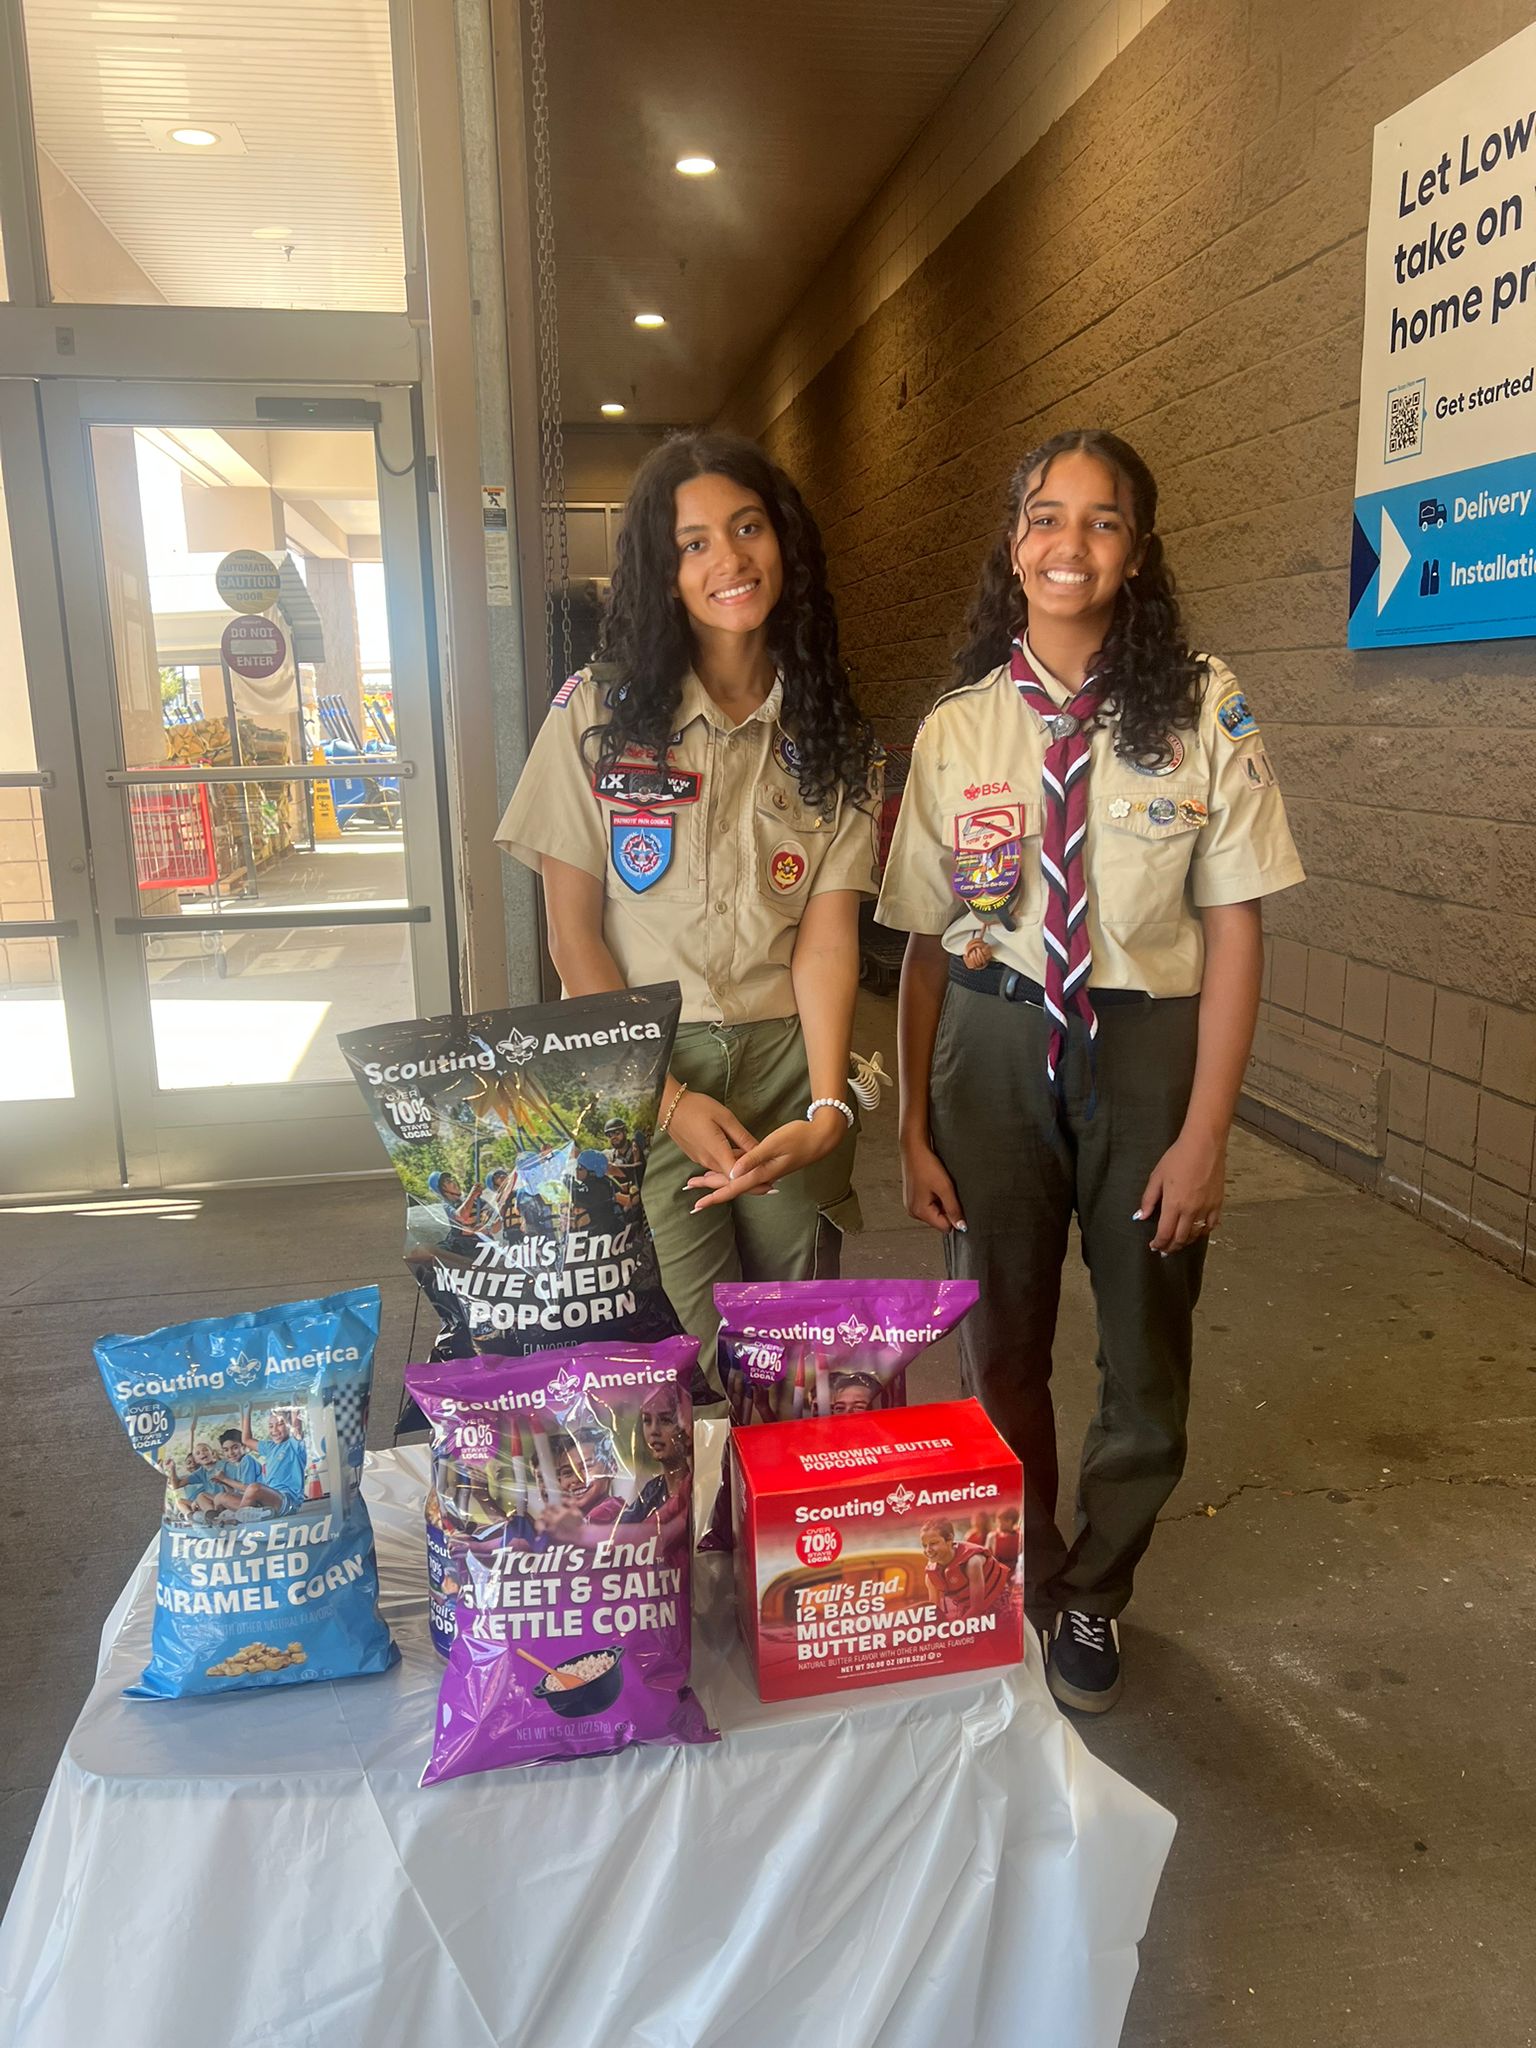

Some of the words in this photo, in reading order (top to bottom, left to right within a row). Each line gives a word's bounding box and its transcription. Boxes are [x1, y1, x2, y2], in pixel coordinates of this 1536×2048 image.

[1399, 152, 1451, 218] Let
[1460, 110, 1536, 185] Low
[1394, 221, 1467, 284] take
[1476, 194, 1522, 246] on
[1390, 285, 1482, 354] home
[1491, 260, 1536, 325] pr
[1435, 393, 1465, 419] Get
[1468, 367, 1534, 409] started
[1453, 489, 1532, 523] Delivery
[223, 563, 275, 572] AUTOMATIC
[219, 575, 277, 588] CAUTION
[236, 591, 263, 601] DOOR
[231, 628, 246, 638] DO
[250, 627, 275, 638] NOT
[236, 656, 274, 667] ENTER
[982, 781, 1012, 797] BSA
[363, 1049, 497, 1086] Scouting
[542, 1020, 662, 1055] America
[385, 1090, 418, 1103] OVER
[385, 1097, 431, 1126] 70%
[400, 1123, 429, 1132] STAYS
[402, 1130, 432, 1140] LOCAL
[471, 1235, 556, 1270] Trail's
[565, 1223, 631, 1265] End
[468, 1289, 638, 1331] POPCORN
[743, 1322, 835, 1346] Scouting
[754, 1341, 781, 1351] OVER
[747, 1346, 782, 1373] 70%
[750, 1367, 775, 1376] STAYS
[116, 1368, 225, 1401] Scouting
[264, 1346, 359, 1377] America
[750, 1372, 775, 1381] LOCAL
[440, 1388, 547, 1417] Scouting
[582, 1367, 678, 1392] America
[129, 1404, 160, 1414] OVER
[125, 1410, 168, 1437] 70%
[132, 1440, 162, 1450] LOCAL
[799, 1447, 893, 1464] MICROWAVE
[894, 1438, 954, 1453] BUTTER
[804, 1456, 879, 1472] POPCORN
[795, 1498, 886, 1524] Scouting
[916, 1483, 998, 1508] America
[168, 1529, 265, 1561] Trail's
[266, 1514, 332, 1552] End
[801, 1532, 837, 1554] 70%
[806, 1526, 831, 1535] OVER
[490, 1543, 585, 1577] Trail's
[591, 1536, 658, 1571] End
[807, 1551, 832, 1559] STAYS
[807, 1556, 832, 1564] LOCAL
[191, 1551, 310, 1588] SALTED
[156, 1579, 280, 1615] CARAMEL
[288, 1554, 365, 1607] CORN
[462, 1578, 561, 1610] SWEET
[570, 1576, 592, 1604] &
[601, 1567, 681, 1602] SALTY
[794, 1583, 856, 1607] Trail's
[859, 1576, 899, 1598] End
[472, 1608, 583, 1641] KETTLE
[592, 1600, 677, 1635] CORN
[796, 1606, 817, 1623] 12
[823, 1596, 886, 1620] BAGS
[796, 1605, 937, 1641] MICROWAVE
[797, 1633, 887, 1661] BUTTER
[892, 1613, 996, 1647] POPCORN
[798, 1661, 827, 1671] NATURAL
[828, 1656, 853, 1667] BUTTER
[854, 1652, 878, 1662] FLAVOR
[879, 1649, 895, 1658] WITH
[896, 1645, 918, 1656] OTHER
[919, 1642, 947, 1652] NATURAL
[947, 1636, 975, 1648] FLAVORS
[840, 1665, 853, 1673] NET
[516, 1728, 532, 1741] NET
[534, 1726, 547, 1739] WT
[564, 1725, 576, 1737] OZ
